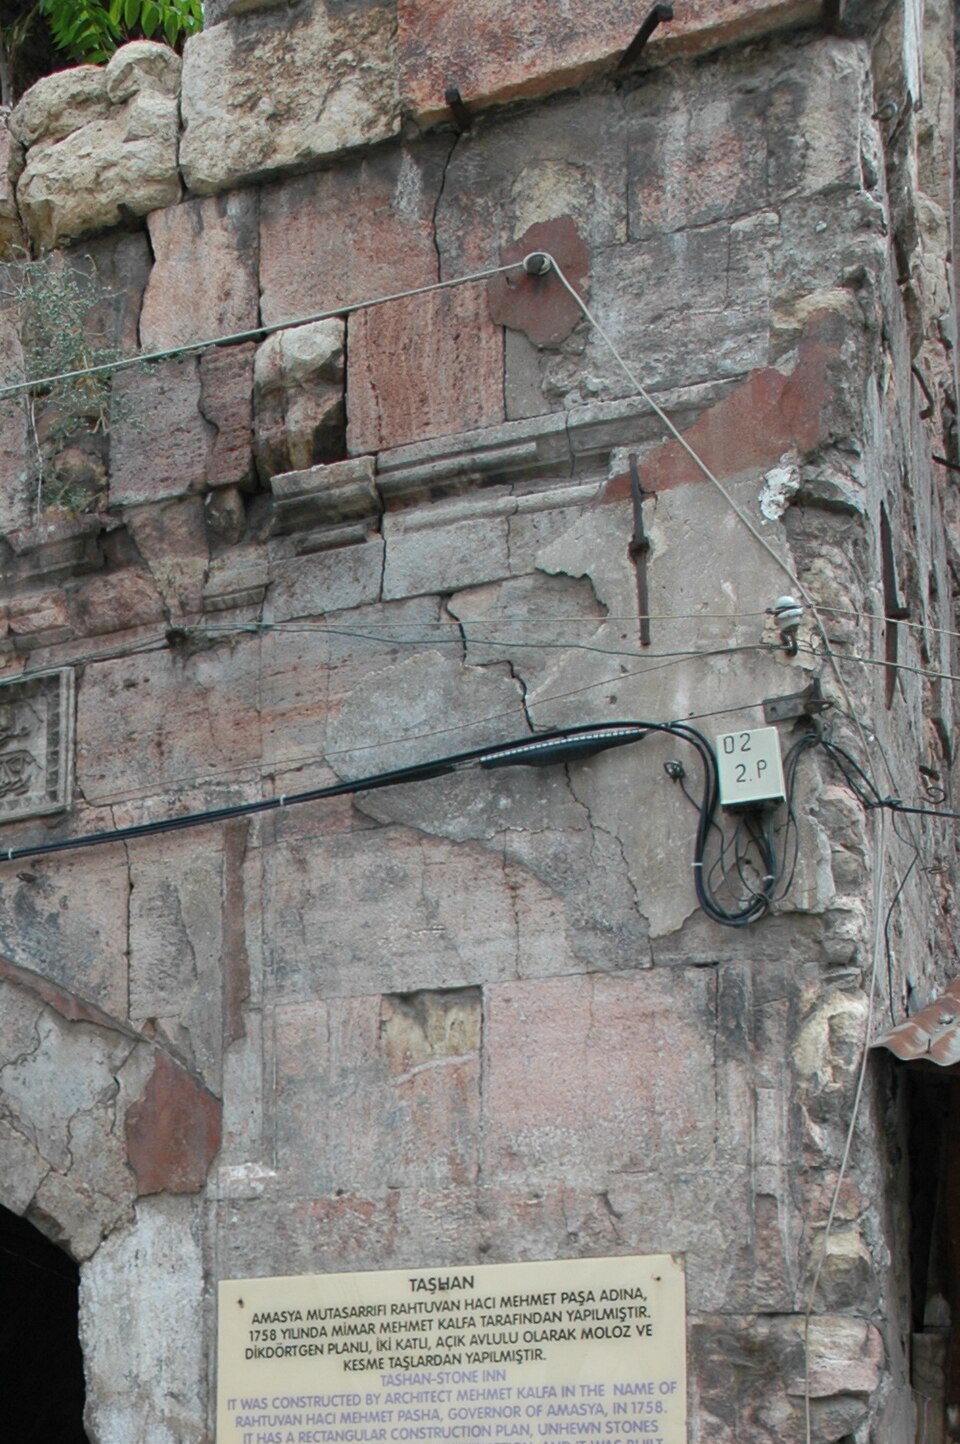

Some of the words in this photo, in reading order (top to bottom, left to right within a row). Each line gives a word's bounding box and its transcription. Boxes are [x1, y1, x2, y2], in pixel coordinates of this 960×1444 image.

[409, 1276, 474, 1294] TAŞHAN
[252, 1310, 302, 1324] AMASYA
[307, 1305, 386, 1320] MUTASARRIFI
[391, 1300, 460, 1315] RAHTUVAN
[464, 1298, 496, 1309] HACI
[500, 1293, 556, 1308] MEHMET
[561, 1291, 598, 1306] PAŞA
[600, 1288, 647, 1302] ADINA,
[249, 1329, 276, 1342] 1758
[281, 1326, 327, 1340] YILINDA
[331, 1323, 375, 1336] MİMAR
[380, 1319, 433, 1333] MEHMET
[438, 1319, 476, 1330] KALFA
[481, 1311, 562, 1327] TARAFINDAN
[566, 1306, 651, 1321] YAPILMIŞTIR.
[245, 1343, 324, 1360] DİKDÖRTGEN
[328, 1341, 372, 1355] PLANLI,
[376, 1337, 391, 1351] İKİ
[396, 1337, 431, 1351] KATLI,
[436, 1335, 465, 1350] AÇIK
[470, 1331, 519, 1346] AVLULU
[523, 1328, 576, 1343] OLARAK
[581, 1325, 631, 1339] MOLOZ
[636, 1324, 652, 1336] VE
[344, 1358, 384, 1372] KESME
[388, 1354, 461, 1371] TAŞLARDAN
[466, 1348, 546, 1365] YAPILMIŞTIR.
[380, 1370, 478, 1387] TASHAN-STONE
[483, 1369, 506, 1382] INN
[227, 1399, 237, 1411] IT
[241, 1398, 268, 1410] WAS
[272, 1393, 361, 1409] CONSTRUCTED
[366, 1393, 381, 1405] BY
[384, 1390, 452, 1404] ARCHITECT
[456, 1387, 512, 1401] MEHMET
[517, 1386, 557, 1399] KALFA
[561, 1385, 576, 1397] IN
[580, 1384, 605, 1396] THE
[613, 1382, 654, 1396] NAME
[658, 1381, 678, 1394] OF
[235, 1415, 302, 1428] RAHTUVAN
[306, 1413, 336, 1425] HACI
[340, 1410, 393, 1424] MEHMET
[398, 1408, 443, 1422] PASHA,
[448, 1406, 521, 1421] GOVERNOR
[525, 1405, 543, 1417] OF
[546, 1402, 608, 1418] AMASYA,
[613, 1402, 627, 1414] IN
[631, 1401, 667, 1414] 1758.
[243, 1432, 253, 1444] IT
[257, 1432, 282, 1444] HAS
[286, 1431, 295, 1443] A
[299, 1428, 386, 1443] RECTANGULAR
[391, 1424, 490, 1440] CONSTRUCTION
[495, 1423, 533, 1437] PLAN,
[538, 1421, 601, 1435] UNHEWN
[605, 1419, 658, 1434] STONES
